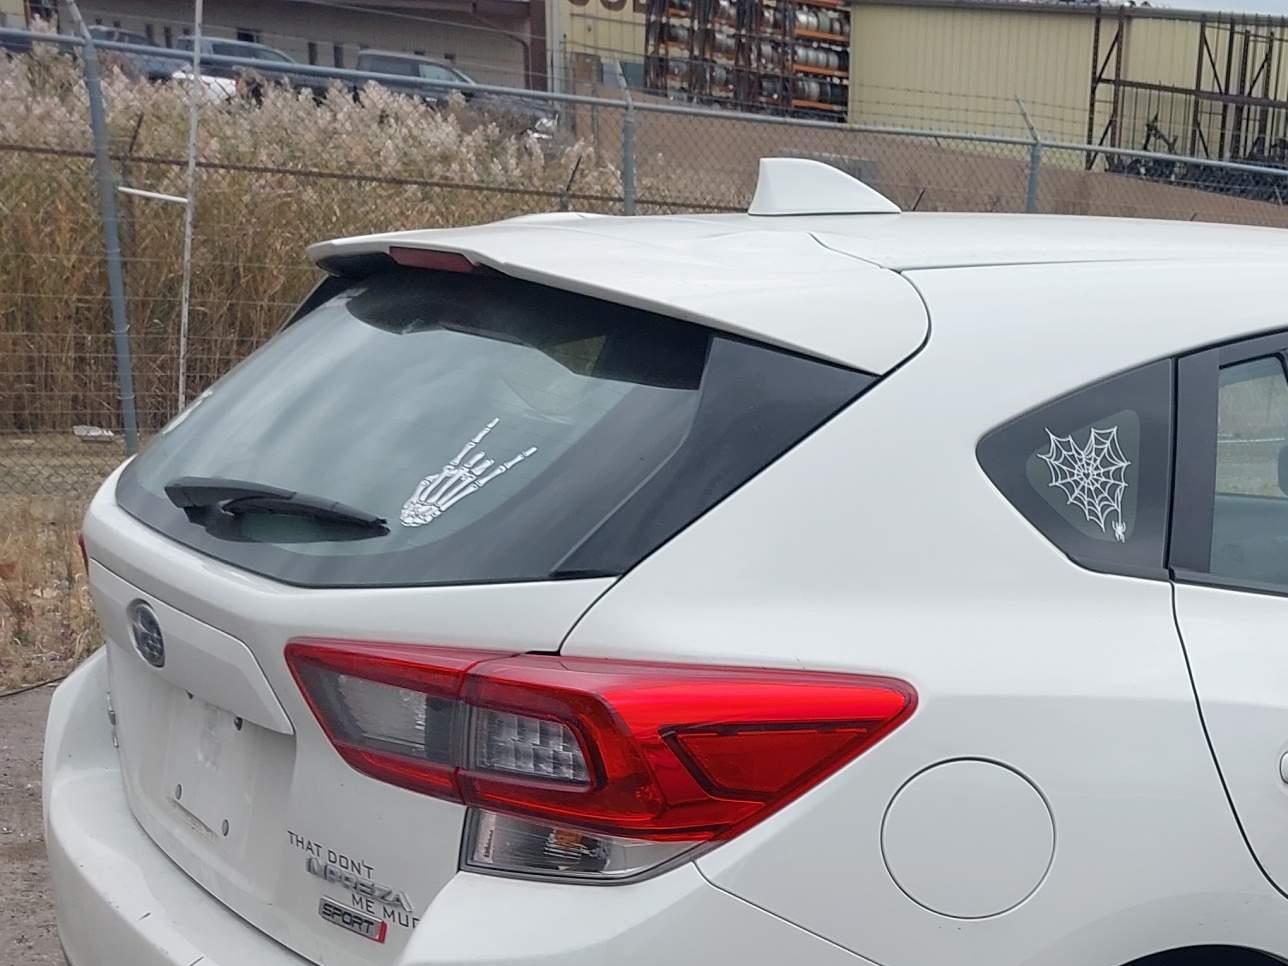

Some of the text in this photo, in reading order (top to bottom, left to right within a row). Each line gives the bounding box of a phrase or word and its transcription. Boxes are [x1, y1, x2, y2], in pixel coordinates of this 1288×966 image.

[287, 830, 375, 880] THAT DON'T
[321, 902, 376, 934] SPORT
[350, 893, 376, 915] ME
